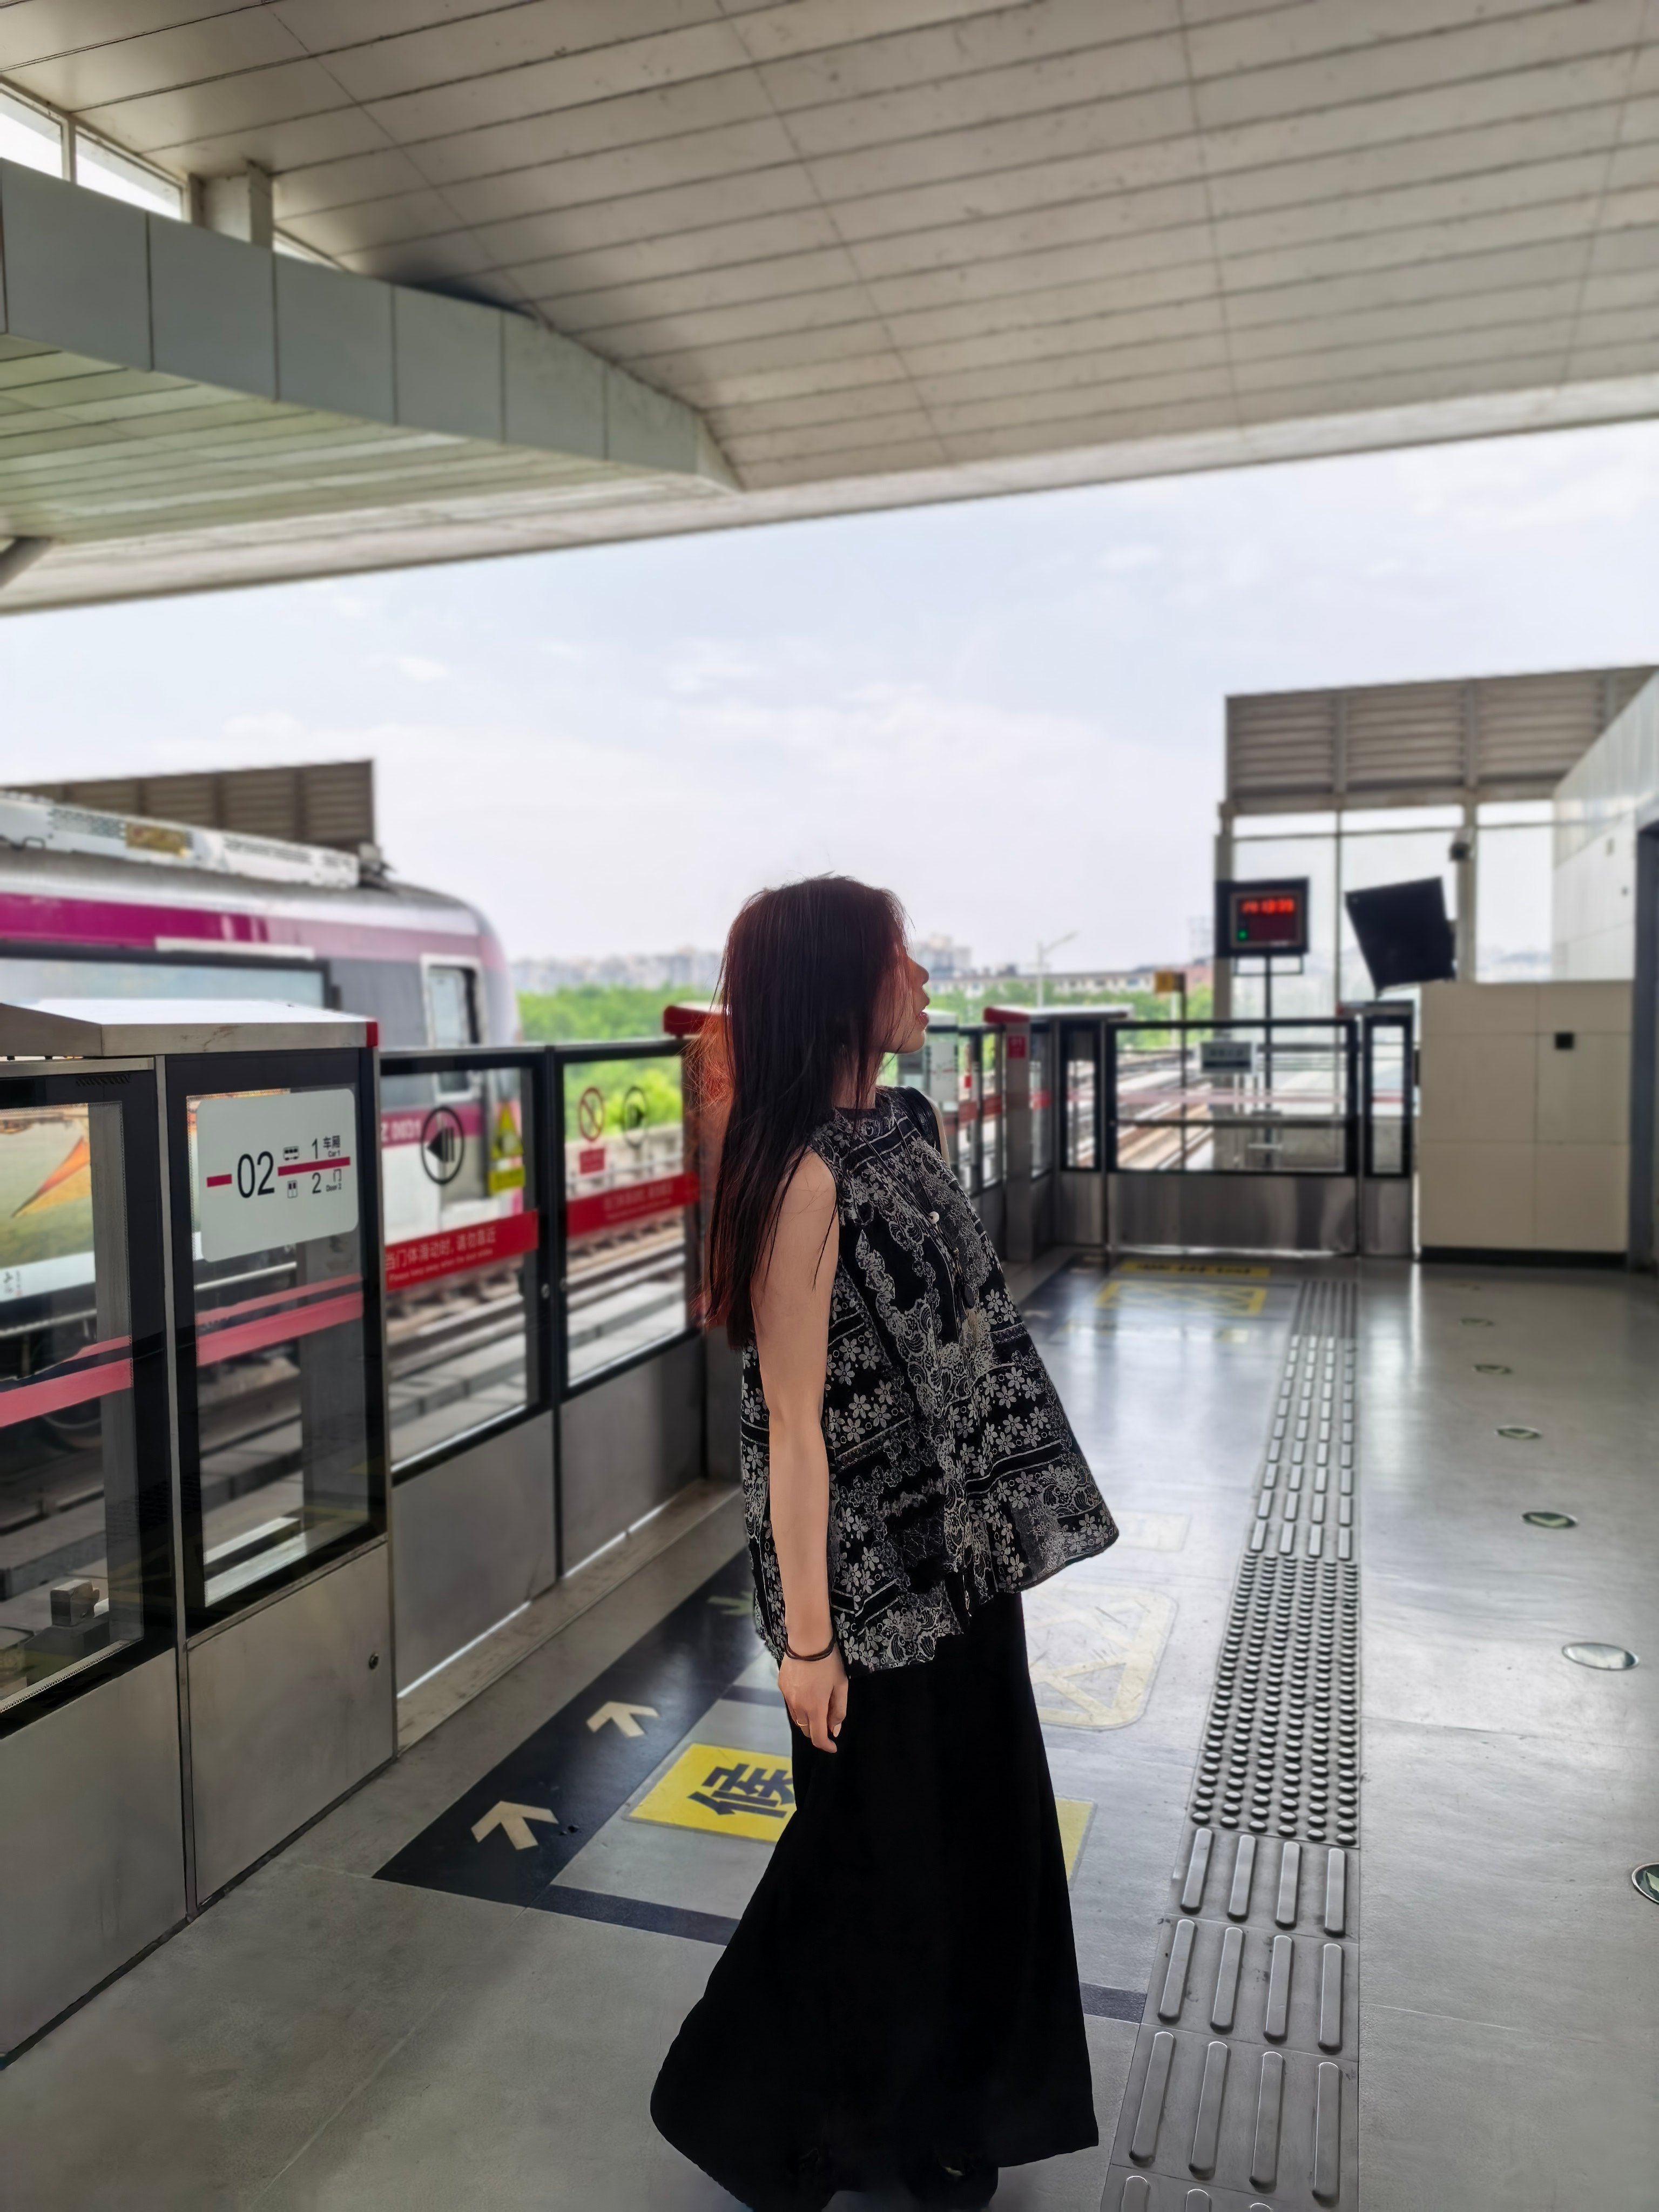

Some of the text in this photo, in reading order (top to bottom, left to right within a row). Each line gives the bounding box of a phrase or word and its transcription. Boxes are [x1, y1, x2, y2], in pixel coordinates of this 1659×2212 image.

[312, 1135, 341, 1159] 1 车厢
[238, 1151, 275, 1198] 02
[312, 1169, 341, 1194] 2 门
